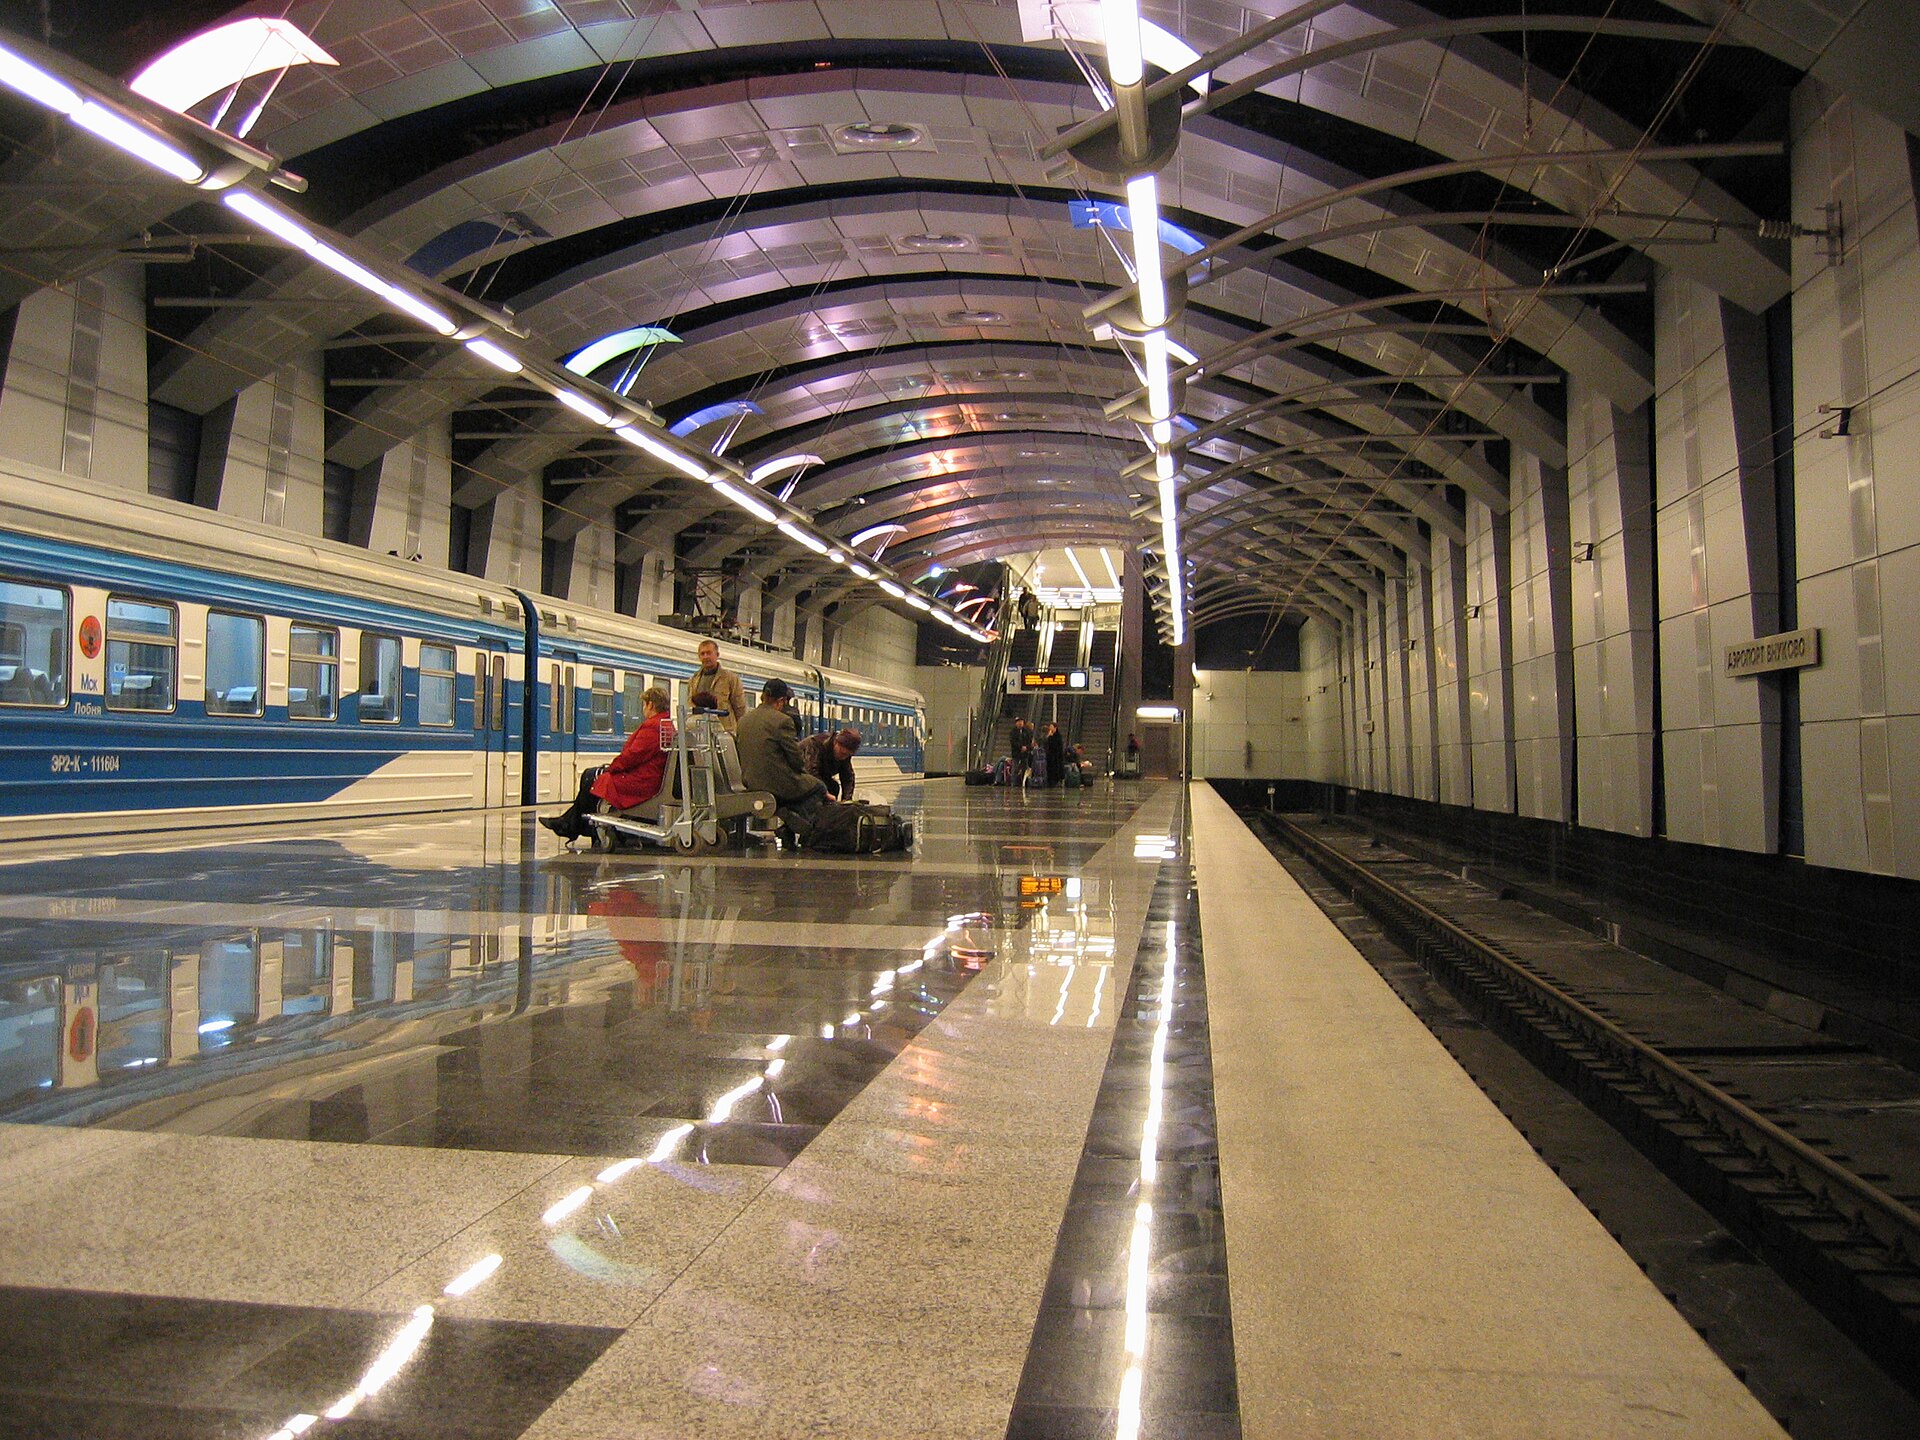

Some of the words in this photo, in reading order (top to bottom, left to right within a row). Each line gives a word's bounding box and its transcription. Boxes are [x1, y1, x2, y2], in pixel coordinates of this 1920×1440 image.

[1766, 637, 1806, 663] ВНУКОВО
[81, 672, 98, 691] Мск
[1009, 678, 1015, 687] 4
[1094, 679, 1101, 688] 3
[74, 701, 102, 716] Лобня
[51, 754, 81, 773] ЭР2-К
[91, 754, 120, 772] 111604
